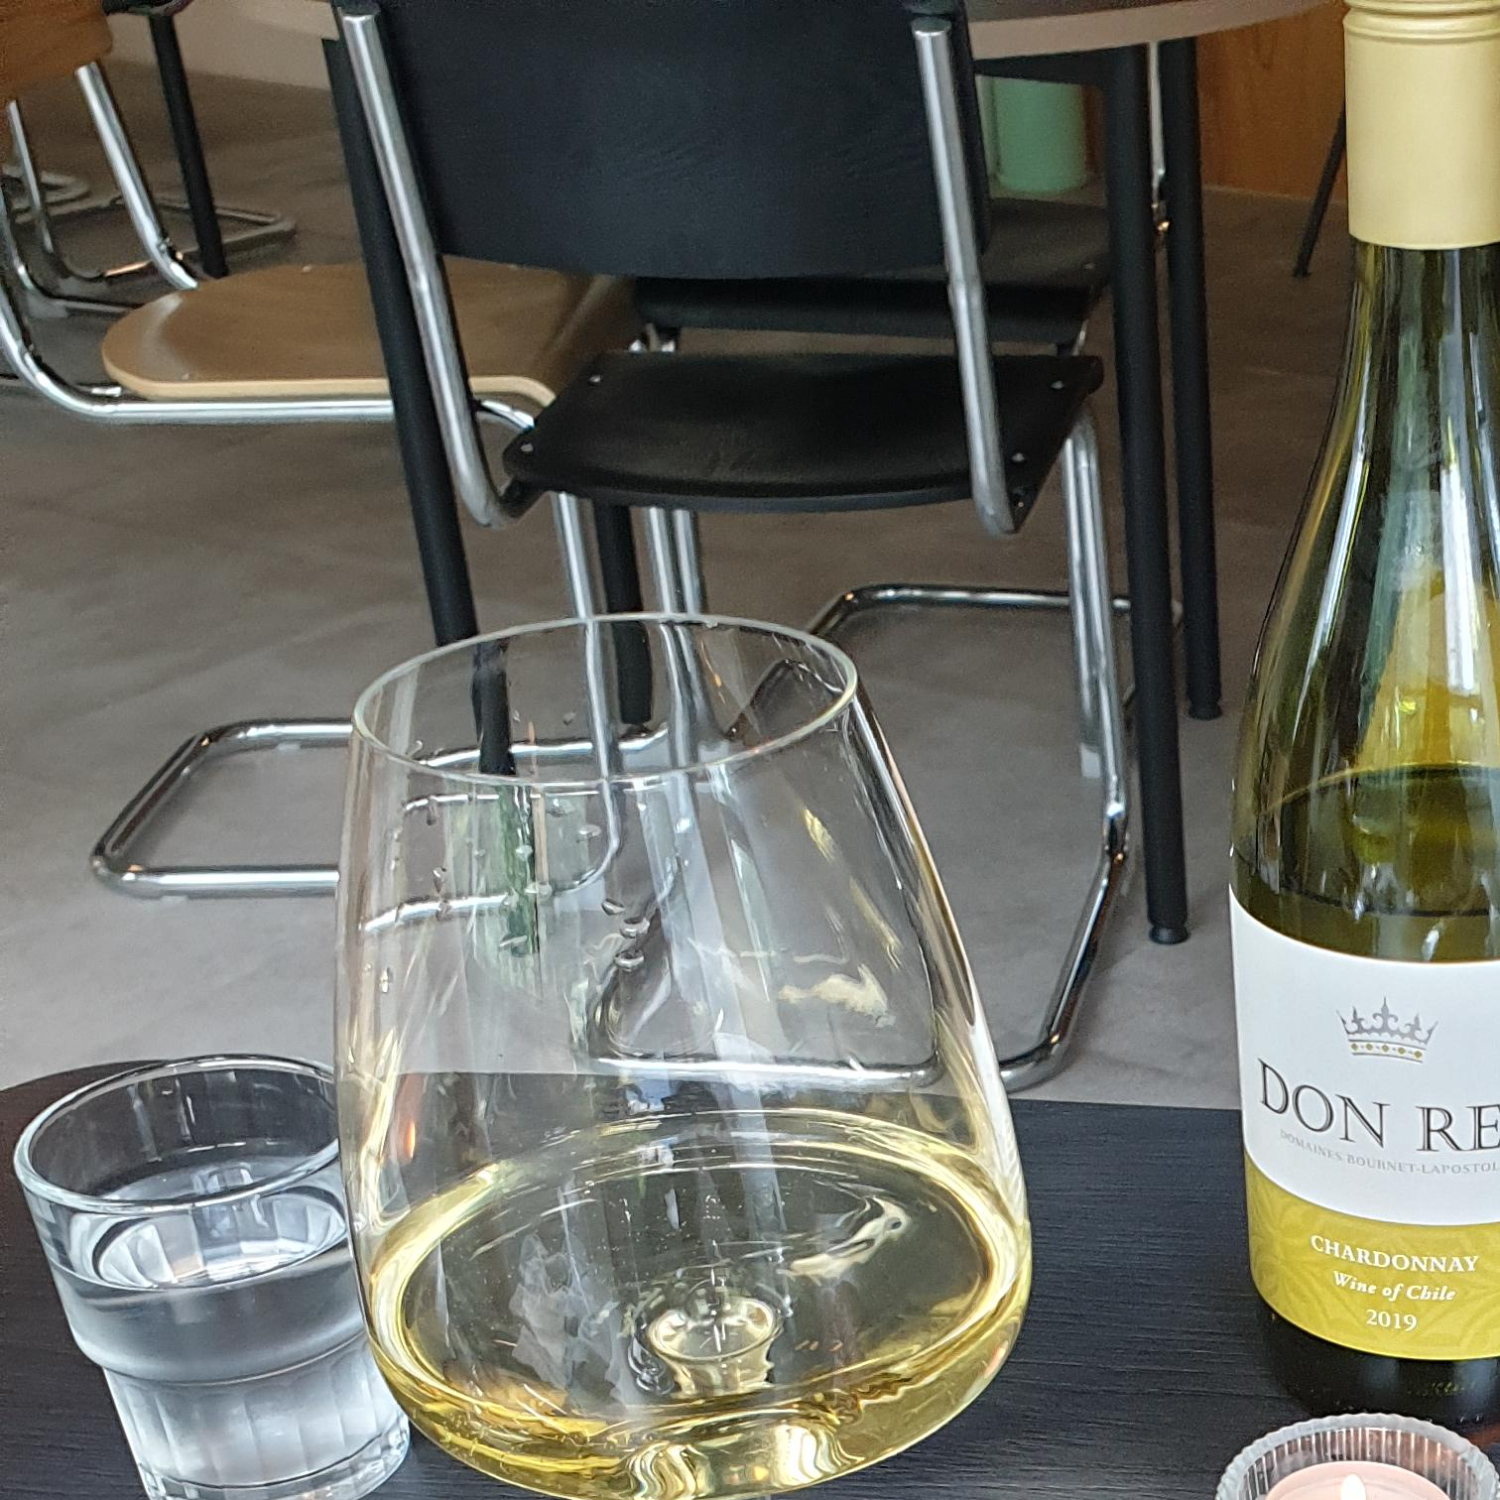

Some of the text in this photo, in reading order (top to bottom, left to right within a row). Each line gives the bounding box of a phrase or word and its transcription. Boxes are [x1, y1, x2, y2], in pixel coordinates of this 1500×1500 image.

[1257, 1057, 1391, 1148] DON
[1280, 1129, 1343, 1162] DOMAINES
[1310, 1234, 1479, 1273] CHARDONNAY
[1333, 1270, 1456, 1302] Wine of Chile
[1366, 1308, 1417, 1332] 2019
